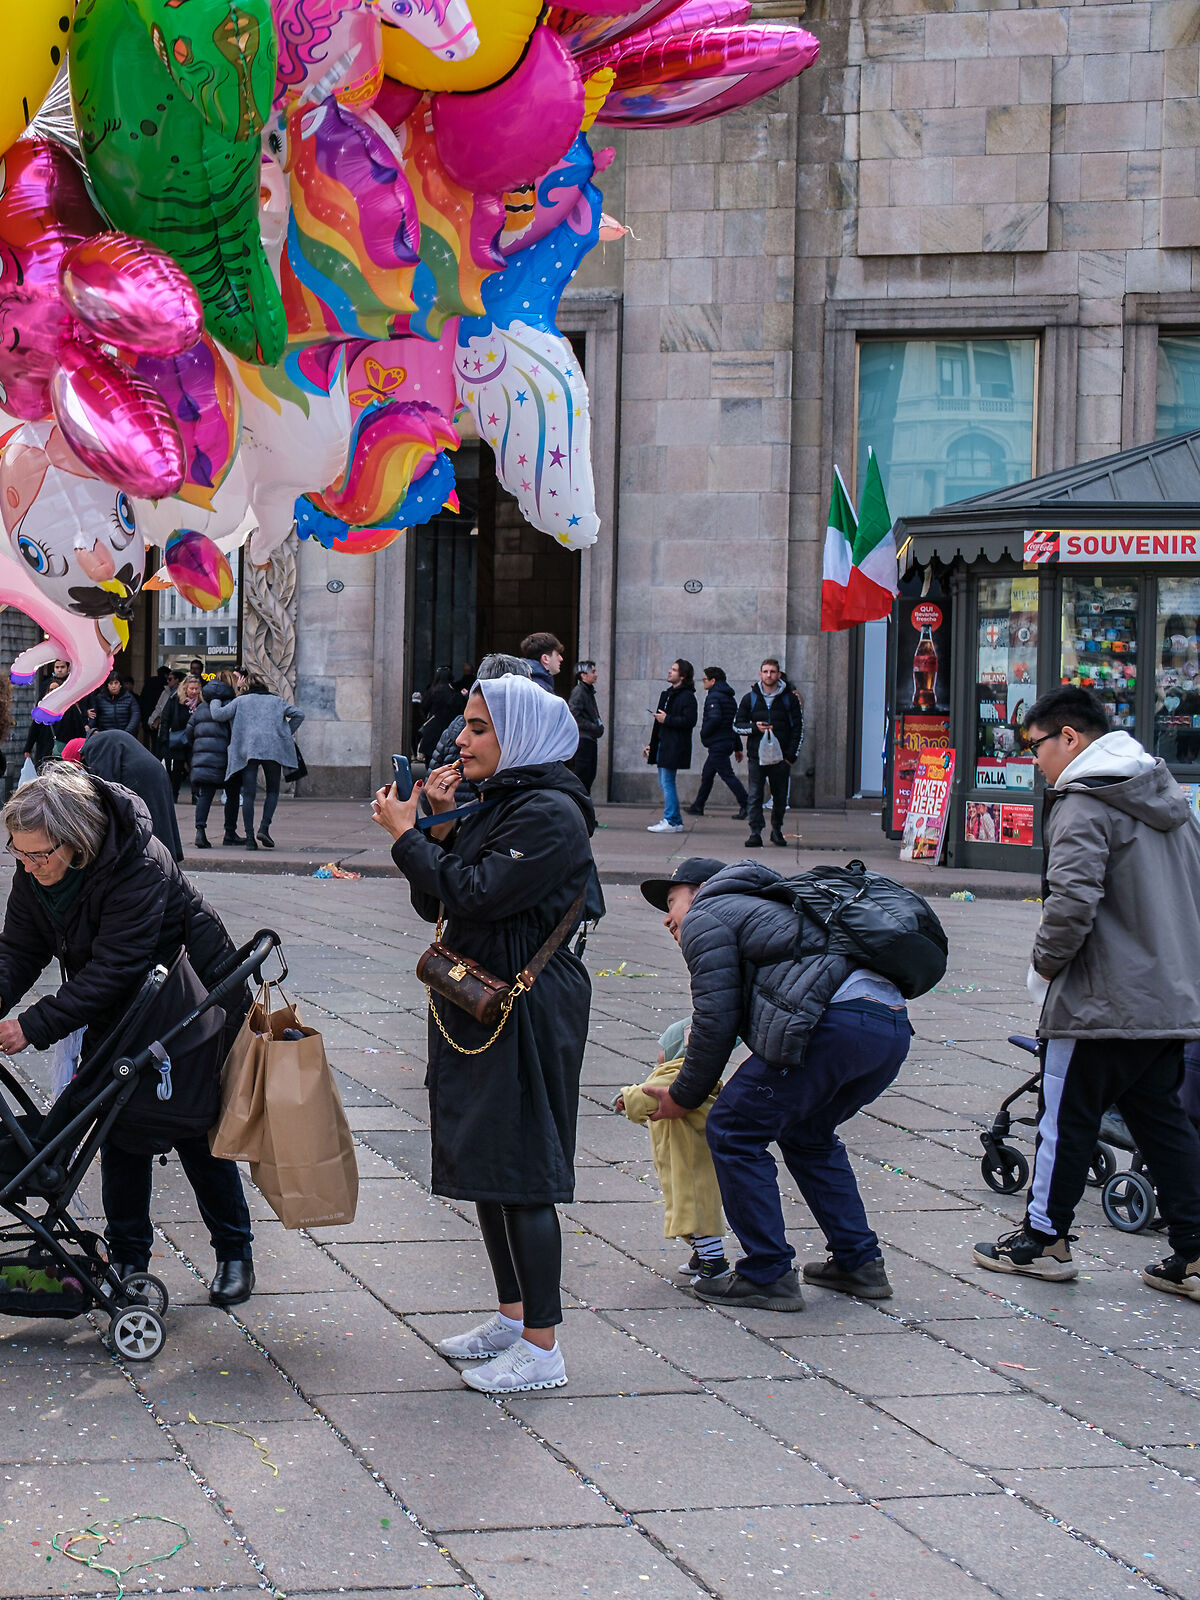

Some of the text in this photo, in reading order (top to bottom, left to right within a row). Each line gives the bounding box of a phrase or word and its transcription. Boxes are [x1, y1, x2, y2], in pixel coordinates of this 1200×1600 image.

[1067, 535, 1197, 555] SOUVENIR
[207, 646, 229, 655] DOPPIO
[981, 673, 1006, 682] MILANO
[977, 771, 1006, 785] ITALIA
[912, 778, 948, 799] TICKETS
[910, 796, 944, 816] HERE
